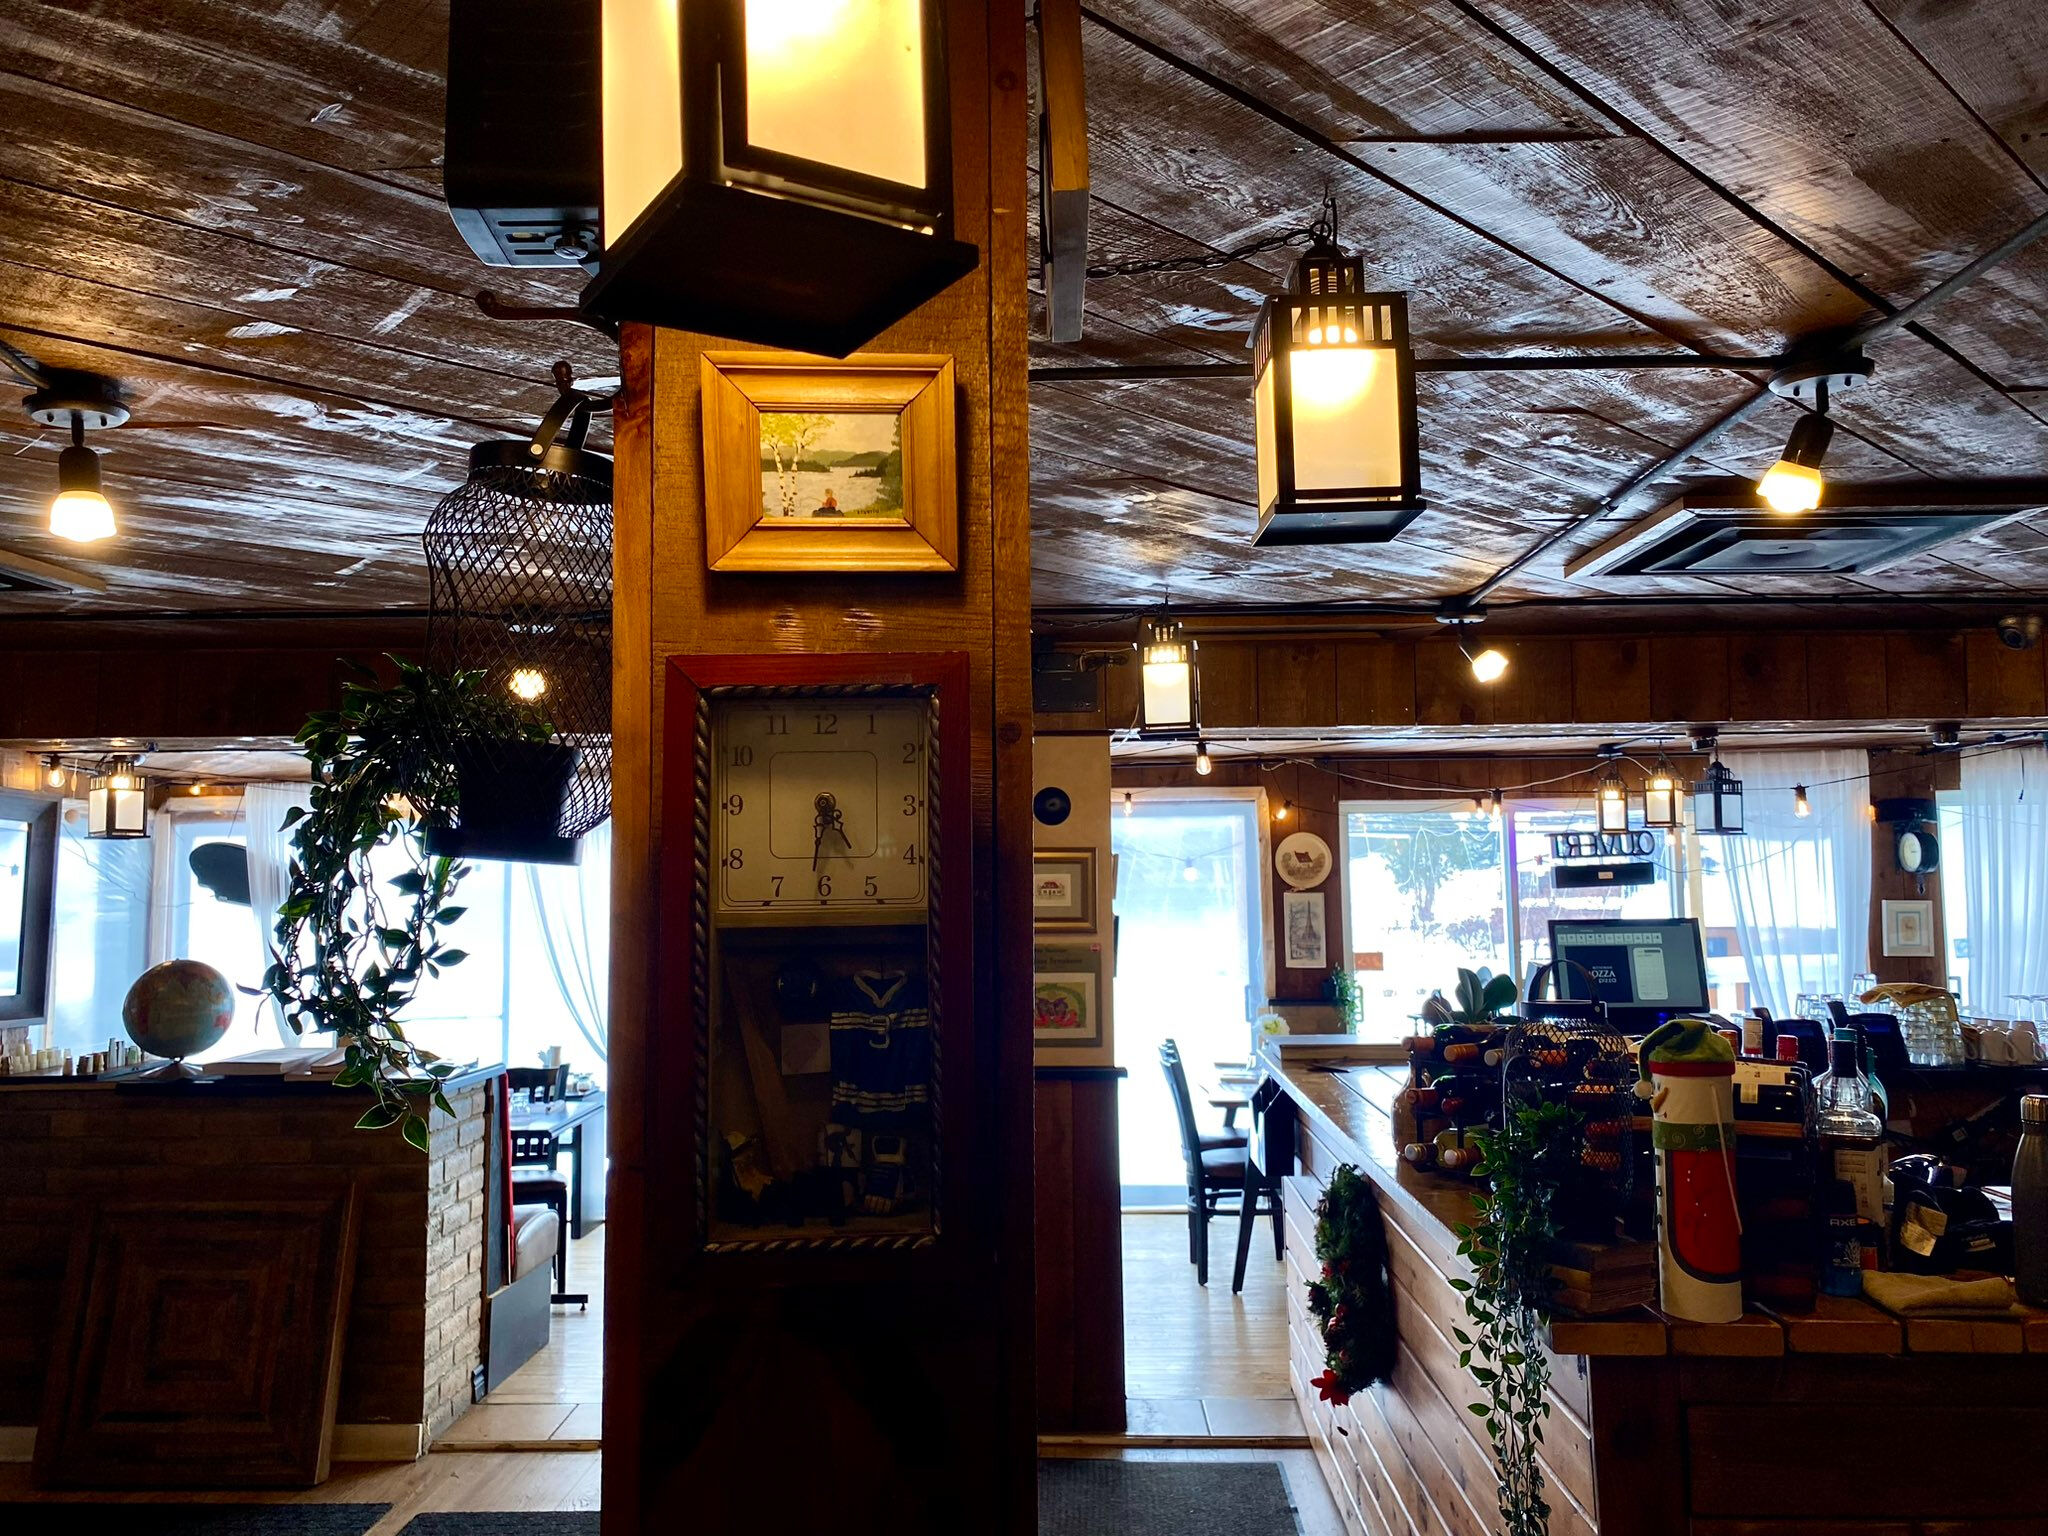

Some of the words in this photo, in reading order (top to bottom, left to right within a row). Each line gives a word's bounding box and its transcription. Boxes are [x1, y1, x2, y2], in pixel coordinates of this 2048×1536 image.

[765, 714, 790, 735] 11
[812, 713, 838, 735] 12
[866, 714, 878, 735] 1
[730, 745, 753, 767] 10
[902, 742, 916, 765] 2
[729, 794, 744, 816] 9
[902, 794, 917, 816] 3
[729, 848, 744, 870] 8
[902, 844, 918, 866] 4
[770, 876, 784, 898] 7
[818, 875, 832, 897] 6
[864, 876, 878, 897] 5
[1829, 1218, 1857, 1227] AXE
